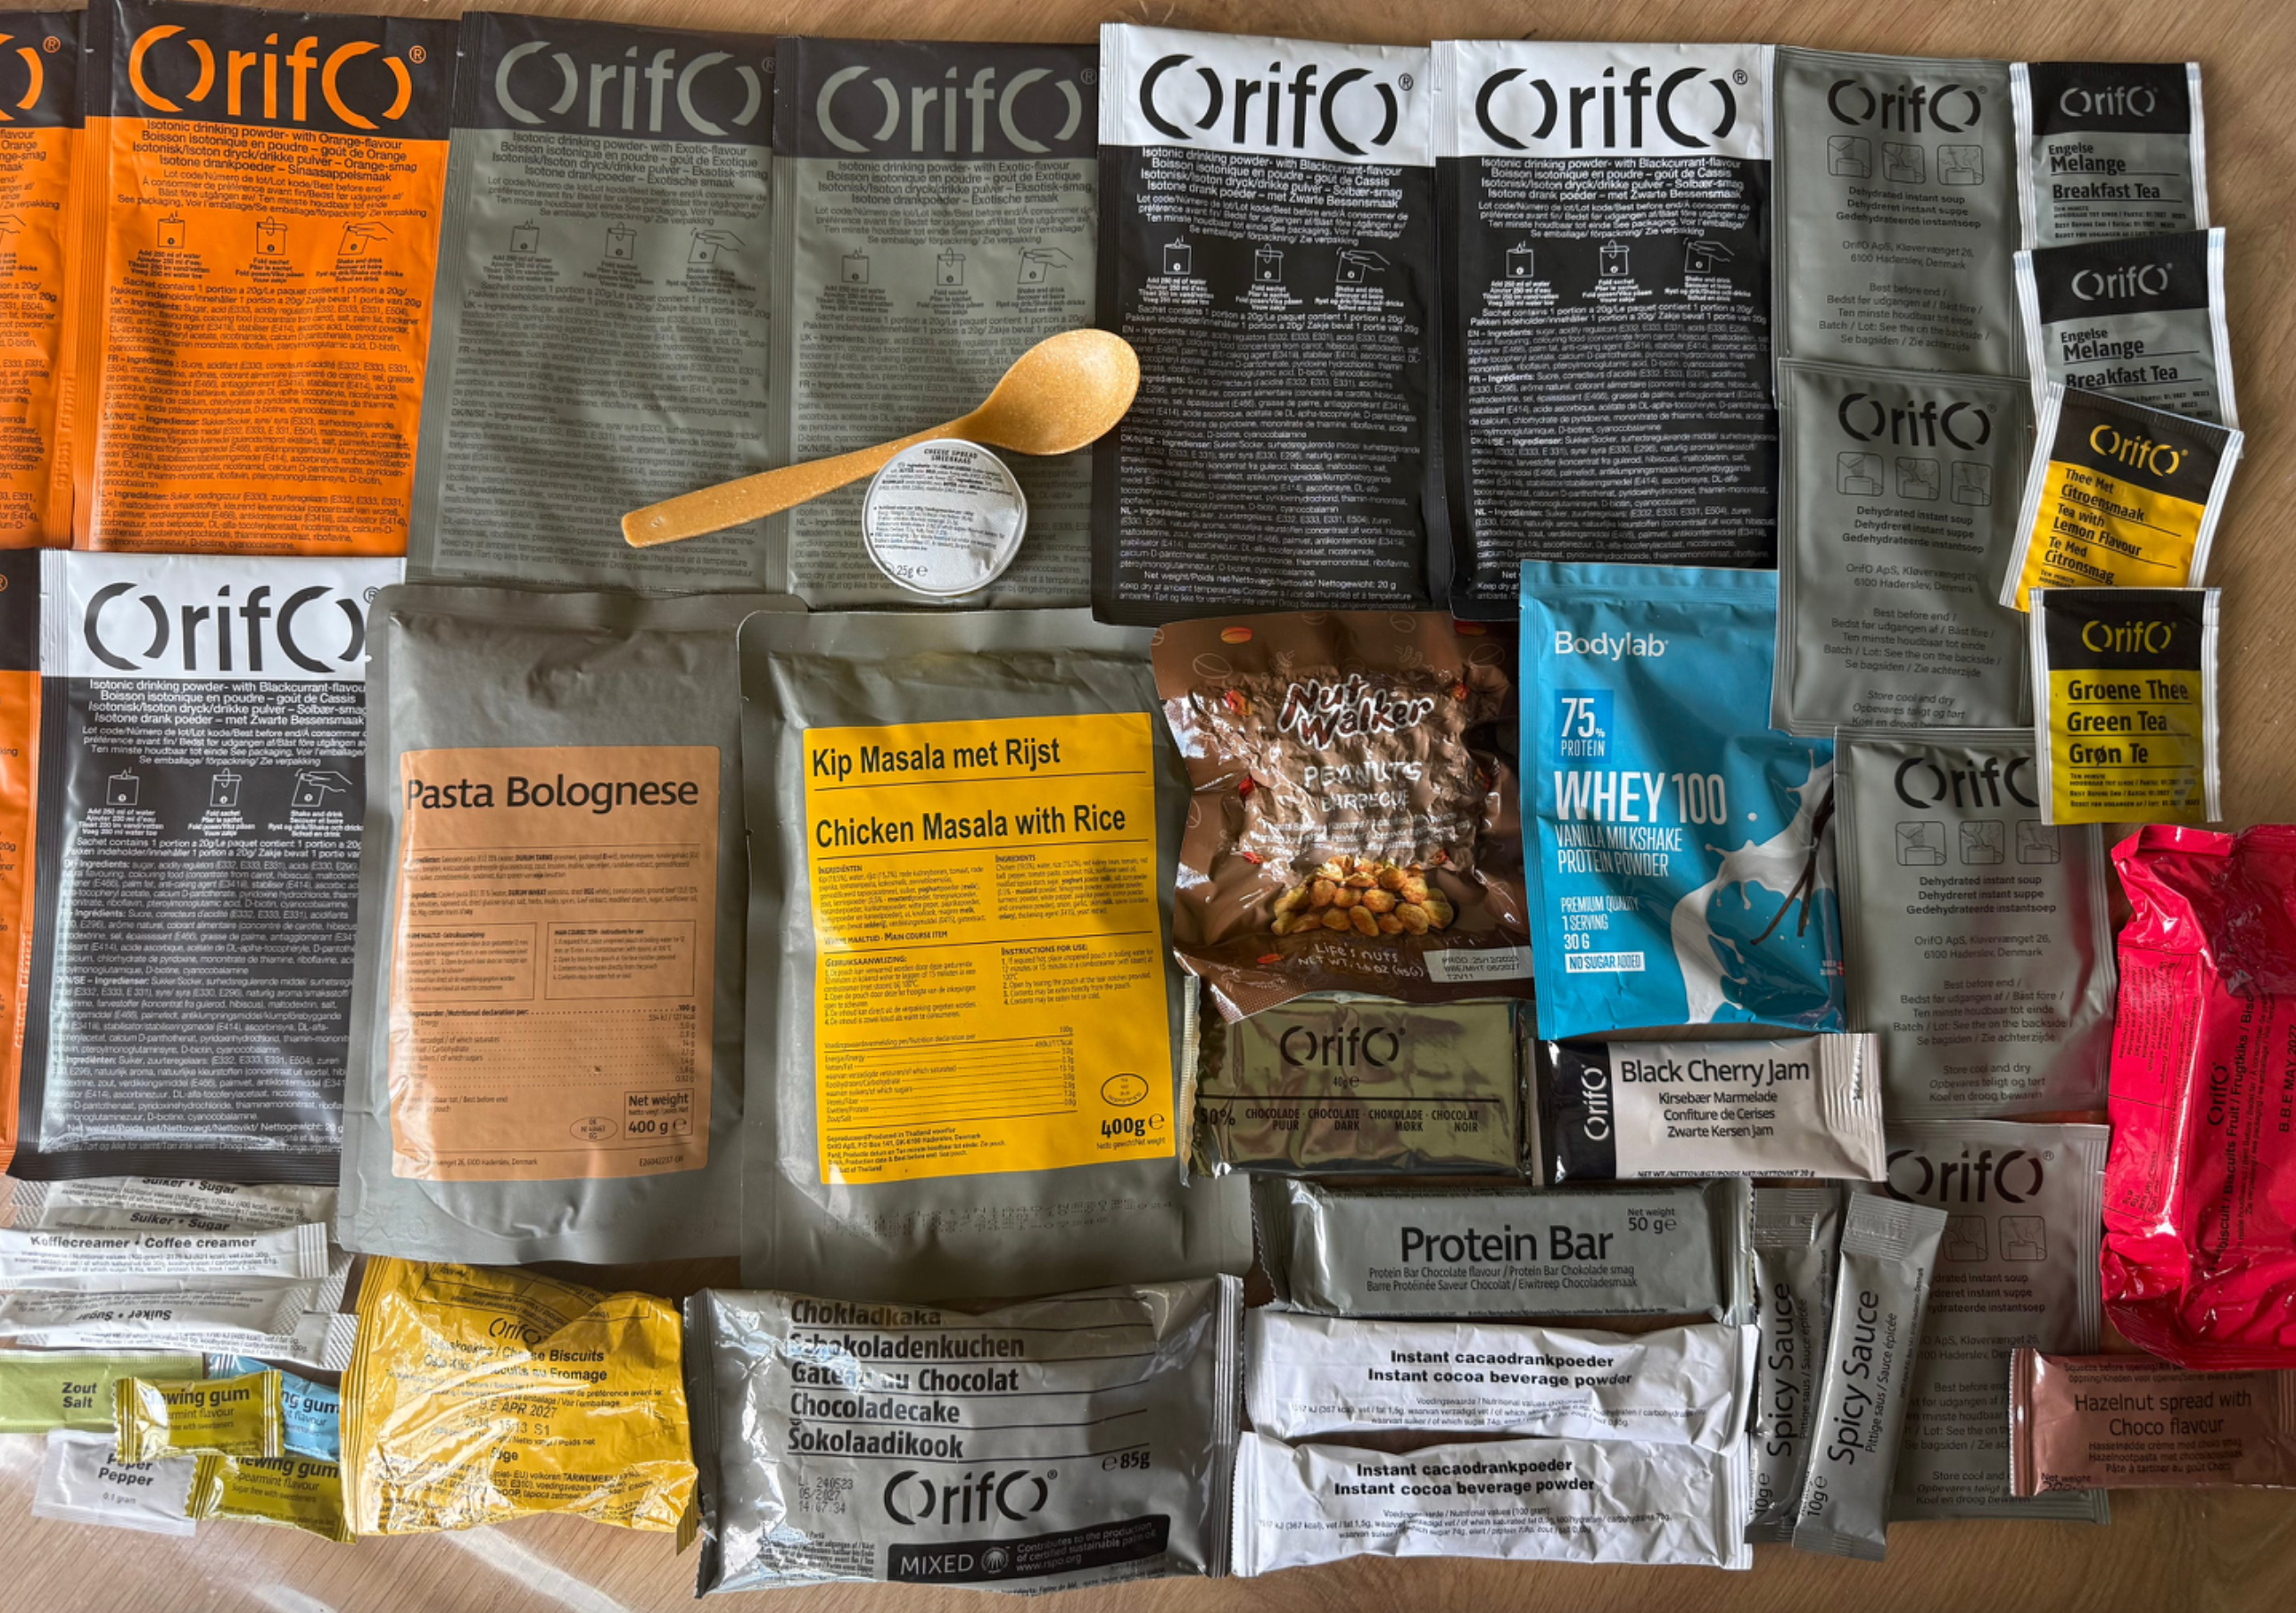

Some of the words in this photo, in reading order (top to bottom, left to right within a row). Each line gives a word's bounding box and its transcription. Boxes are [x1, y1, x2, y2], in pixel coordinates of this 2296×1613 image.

[147, 120, 190, 131] Isotonic
[194, 122, 238, 138] drinking
[293, 129, 317, 141] with
[2048, 143, 2094, 155] Engelse
[2051, 155, 2126, 175] Melange
[2052, 183, 2130, 198] Breakfast
[2135, 183, 2160, 198] Tea
[2061, 328, 2108, 343] Engelse
[2063, 340, 2144, 360] Melange
[2066, 368, 2147, 388] Breakfast
[2151, 366, 2177, 380] Tea
[2065, 467, 2094, 485] Thee
[2095, 476, 2114, 494] Met
[2061, 484, 2144, 522] Citroensmaak
[2058, 503, 2076, 517] Tea
[2079, 510, 2105, 527] with
[2049, 536, 2062, 549] Te
[2065, 541, 2087, 558] Med
[2053, 517, 2095, 540] Lemon
[2099, 530, 2142, 556] Flavour
[896, 565, 913, 578] 25g
[2044, 550, 2115, 584] Citronsmag
[1555, 631, 1665, 661] Bodylab
[2068, 680, 2141, 700] Groene
[2145, 679, 2188, 699] Thee
[1278, 674, 1370, 732] Nut
[1298, 689, 1433, 750] Walker
[2067, 711, 2131, 732] Green
[2137, 711, 2167, 731] Tea
[1561, 740, 1605, 757] PROTEIN
[2069, 743, 2122, 765] Grøn
[2129, 743, 2148, 763] Te
[813, 748, 852, 782] Kip
[861, 741, 945, 773] Masala
[954, 744, 997, 769] met
[1006, 737, 1061, 771] Rijst
[1303, 761, 1423, 788] PEANUTS
[408, 778, 494, 810] Pasta
[507, 774, 698, 815] Bolognese
[1554, 771, 1665, 823] WHEY
[1672, 773, 1727, 825] 100
[816, 816, 914, 848] Chicken
[922, 808, 1009, 841] Masala
[1016, 806, 1067, 836] with
[1075, 804, 1126, 831] Rice
[1555, 824, 1606, 848] VANILLA
[1606, 827, 1683, 852] MILKSHAKE
[1558, 850, 1614, 873] PROTEIN
[1616, 852, 1669, 877] POWDER
[1563, 916, 1568, 931] 1
[1570, 914, 1608, 931] SERVING
[1564, 934, 1580, 949] 30
[1582, 935, 1590, 949] G
[1569, 956, 1582, 969] NO
[1585, 956, 1615, 969] SUGAR
[1617, 955, 1641, 968] ADDED
[1621, 1059, 1682, 1083] Black
[1688, 1059, 1764, 1088] Cherry
[1767, 1059, 1810, 1087] Jam
[1943, 1065, 1967, 1075] Store
[1970, 1064, 1987, 1073] cool
[1989, 1063, 2010, 1073] and
[2012, 1063, 2031, 1074] dry
[2230, 1034, 2250, 1096] Frugtkiks
[629, 1095, 648, 1106] Net
[650, 1093, 689, 1107] weight
[1658, 1091, 1707, 1104] Kirsebær
[1710, 1091, 1778, 1104] Marmelade
[1245, 1108, 1301, 1121] CHOCOLADE
[1308, 1109, 1360, 1121] CHOCOLATE
[1368, 1110, 1424, 1121] CHOKOLADE
[1432, 1110, 1479, 1121] CHOCOLAT
[1664, 1108, 1718, 1121] Confiture
[1720, 1108, 1735, 1121] de
[1737, 1107, 1775, 1121] Cerises
[629, 1121, 656, 1133] 400
[1102, 1117, 1145, 1138] 400g
[1273, 1120, 1299, 1131] PUUR
[1334, 1121, 1360, 1131] DARK
[1395, 1121, 1424, 1133] MØRK
[1454, 1121, 1478, 1133] NOIR
[1667, 1124, 1709, 1138] Zwarte
[1711, 1125, 1751, 1137] Kersen
[1751, 1125, 1773, 1138] Jam
[129, 1212, 173, 1226] Suiker
[188, 1218, 230, 1233] Sugar
[1628, 1207, 1648, 1216] Net
[1649, 1207, 1675, 1219] weight
[1628, 1217, 1649, 1232] 50
[29, 1236, 130, 1249] Koffiecreamer
[145, 1237, 194, 1248] Coffee
[196, 1238, 257, 1248] creamer
[1400, 1225, 1537, 1263] Protein
[1549, 1225, 1614, 1261] Bar
[1368, 1266, 1401, 1280] Protein
[1403, 1267, 1419, 1278] Bar
[1421, 1265, 1466, 1278] Chocolate
[1468, 1265, 1500, 1278] flavour
[790, 1299, 941, 1328] Chokladkaka
[1768, 1282, 1793, 1373] Sauce
[1843, 1290, 1879, 1380] Sauce
[549, 1349, 605, 1362] Biscuits
[1390, 1350, 1451, 1364] Instant
[1455, 1351, 1615, 1370] cacaodrankpoeder
[549, 1368, 607, 1383] Fromage
[917, 1368, 1020, 1392] Chocolat
[1367, 1368, 1429, 1385] Instant
[1433, 1369, 1485, 1385] cocoa
[1490, 1371, 1570, 1389] beverage
[1574, 1372, 1632, 1388] powder
[62, 1382, 97, 1395] Zout
[210, 1387, 250, 1404] gum
[62, 1396, 93, 1410] Salt
[789, 1392, 961, 1425] Chocoladecake
[2075, 1394, 2154, 1411] Hazelnut
[2160, 1392, 2213, 1413] spread
[2219, 1390, 2251, 1408] with
[1768, 1380, 1800, 1458] Spicy
[1829, 1383, 1872, 1465] Spicy
[2109, 1419, 2164, 1436] Choco
[2170, 1417, 2225, 1434] flavour
[788, 1420, 963, 1459] Šokolaadikook
[1119, 1451, 1151, 1471] 85g
[97, 1468, 153, 1487] Pepper
[900, 1554, 974, 1576] MIXED
